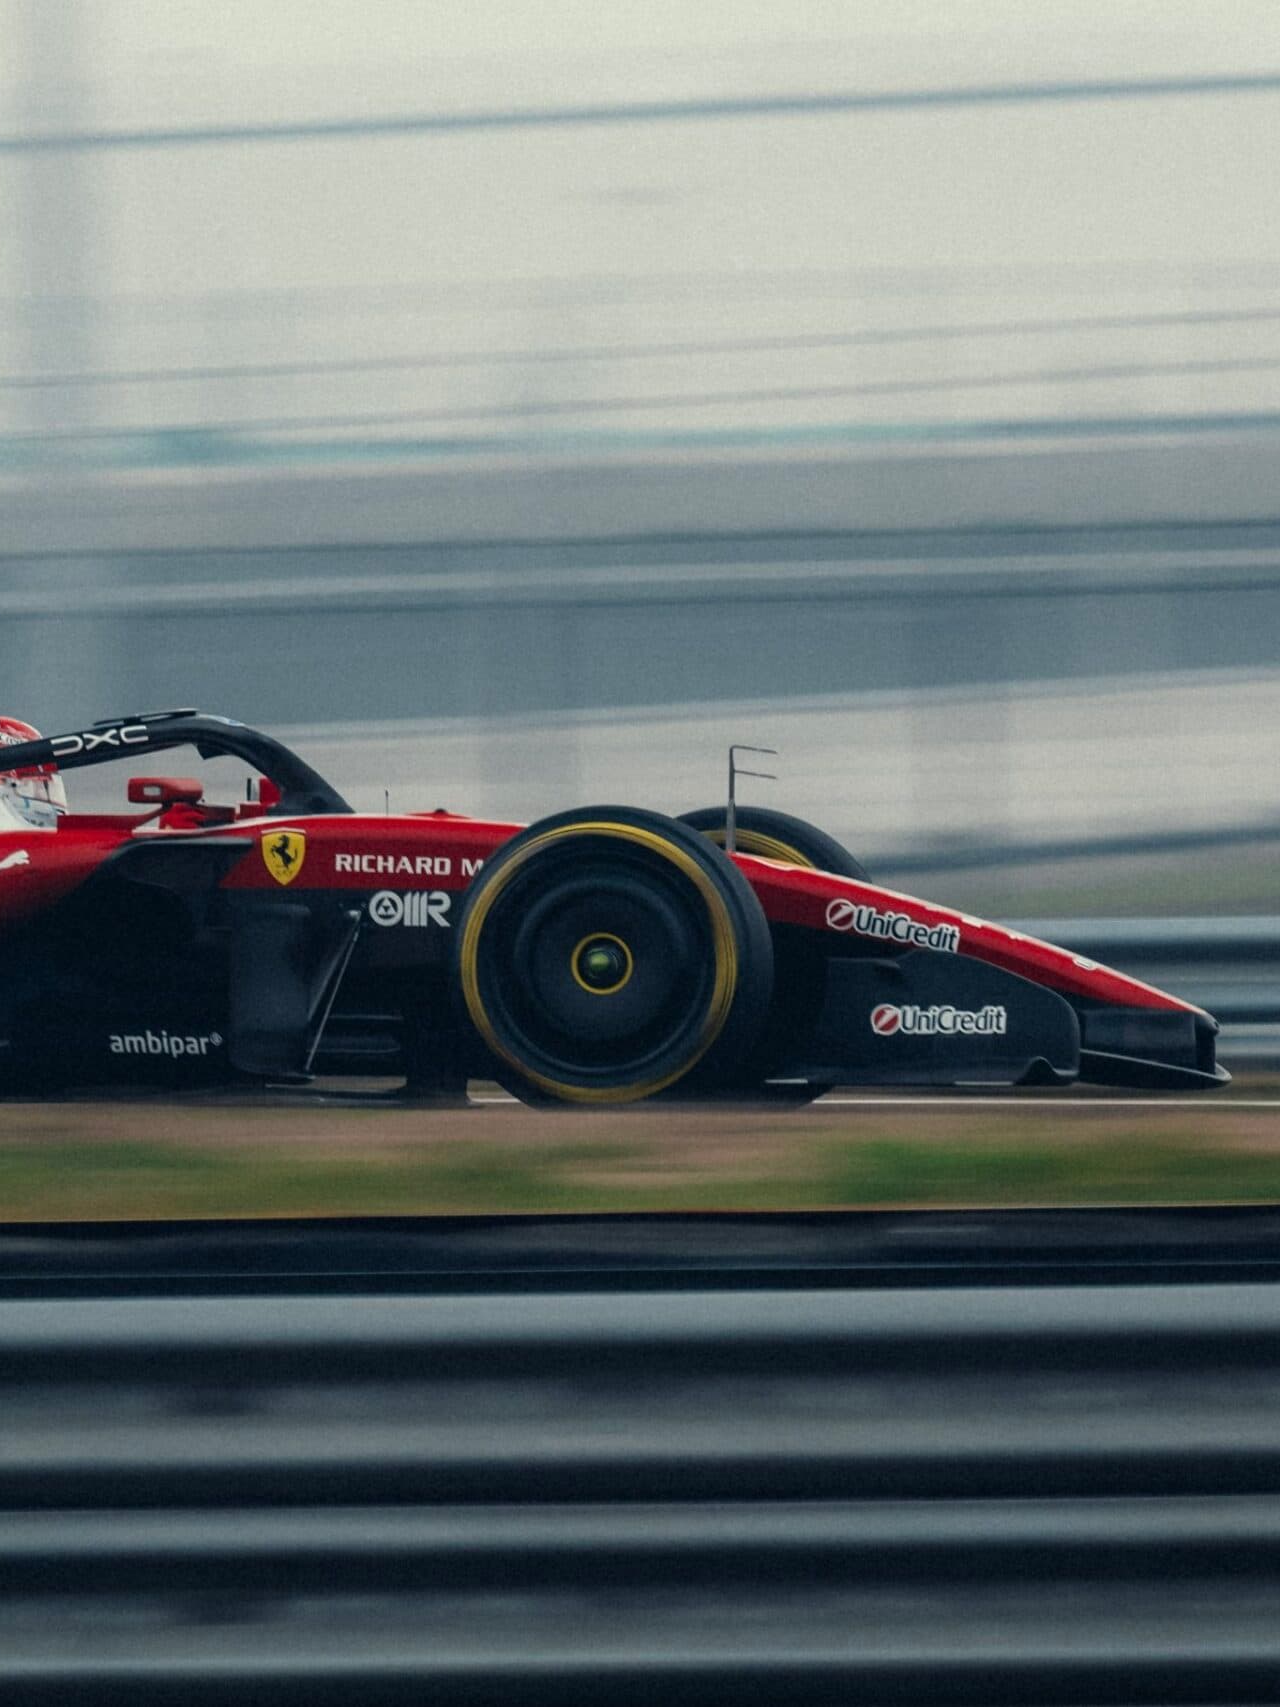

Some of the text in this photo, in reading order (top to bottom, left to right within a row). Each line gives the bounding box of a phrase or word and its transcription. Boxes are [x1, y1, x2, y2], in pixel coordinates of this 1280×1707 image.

[51, 725, 149, 757] DXC
[335, 854, 484, 877] RICHARD M
[855, 906, 959, 952] UniCredit
[899, 1004, 1007, 1034] UniCredit
